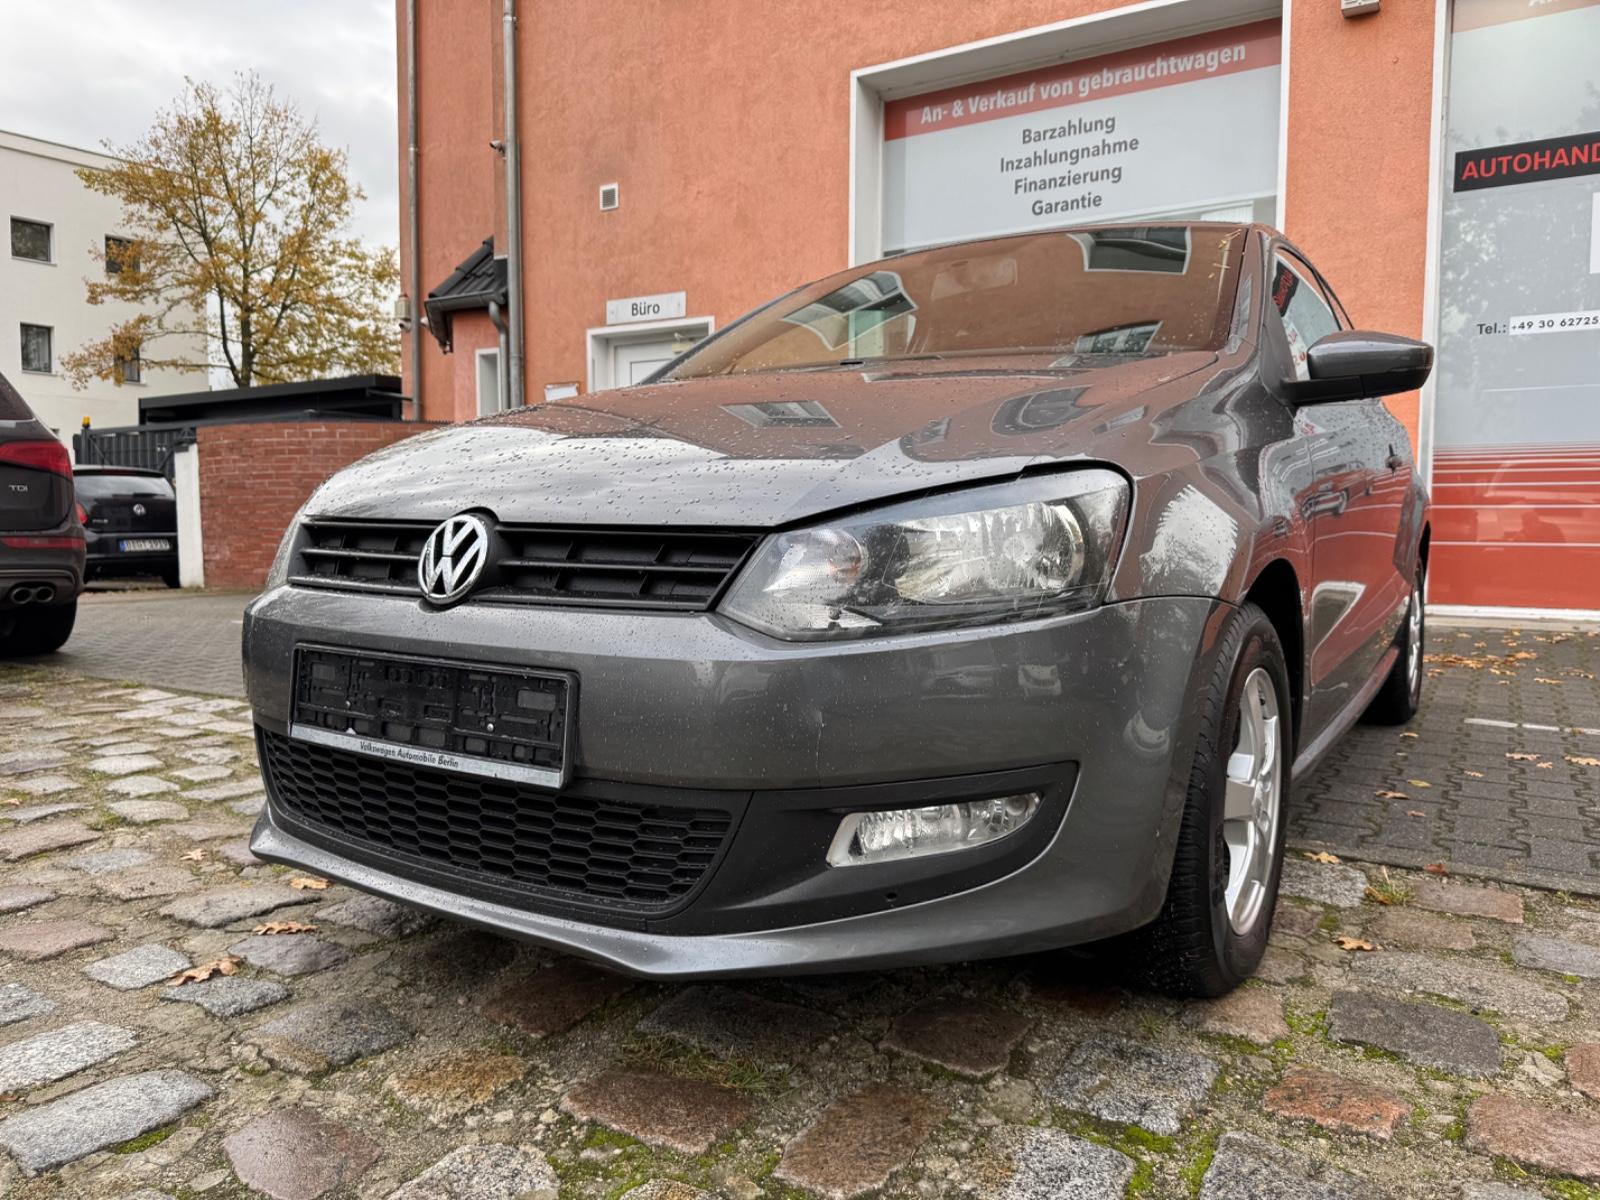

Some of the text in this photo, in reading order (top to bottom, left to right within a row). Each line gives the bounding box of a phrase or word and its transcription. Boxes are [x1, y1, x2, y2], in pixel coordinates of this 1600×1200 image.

[921, 43, 1246, 124] An- & Verkauf von gebrauchtwagen
[1022, 114, 1116, 145] Barzahlung
[1000, 136, 1139, 173] Inzahlungnahme
[1014, 164, 1122, 195] Finanzierung
[1031, 192, 1102, 216] Garantie
[631, 301, 660, 316] Büro
[1477, 322, 1506, 335] Tel.:
[1511, 320, 1534, 330] +49
[1538, 319, 1555, 329] 30
[397, 748, 436, 764] Automobile
[437, 754, 459, 768] Berlin
